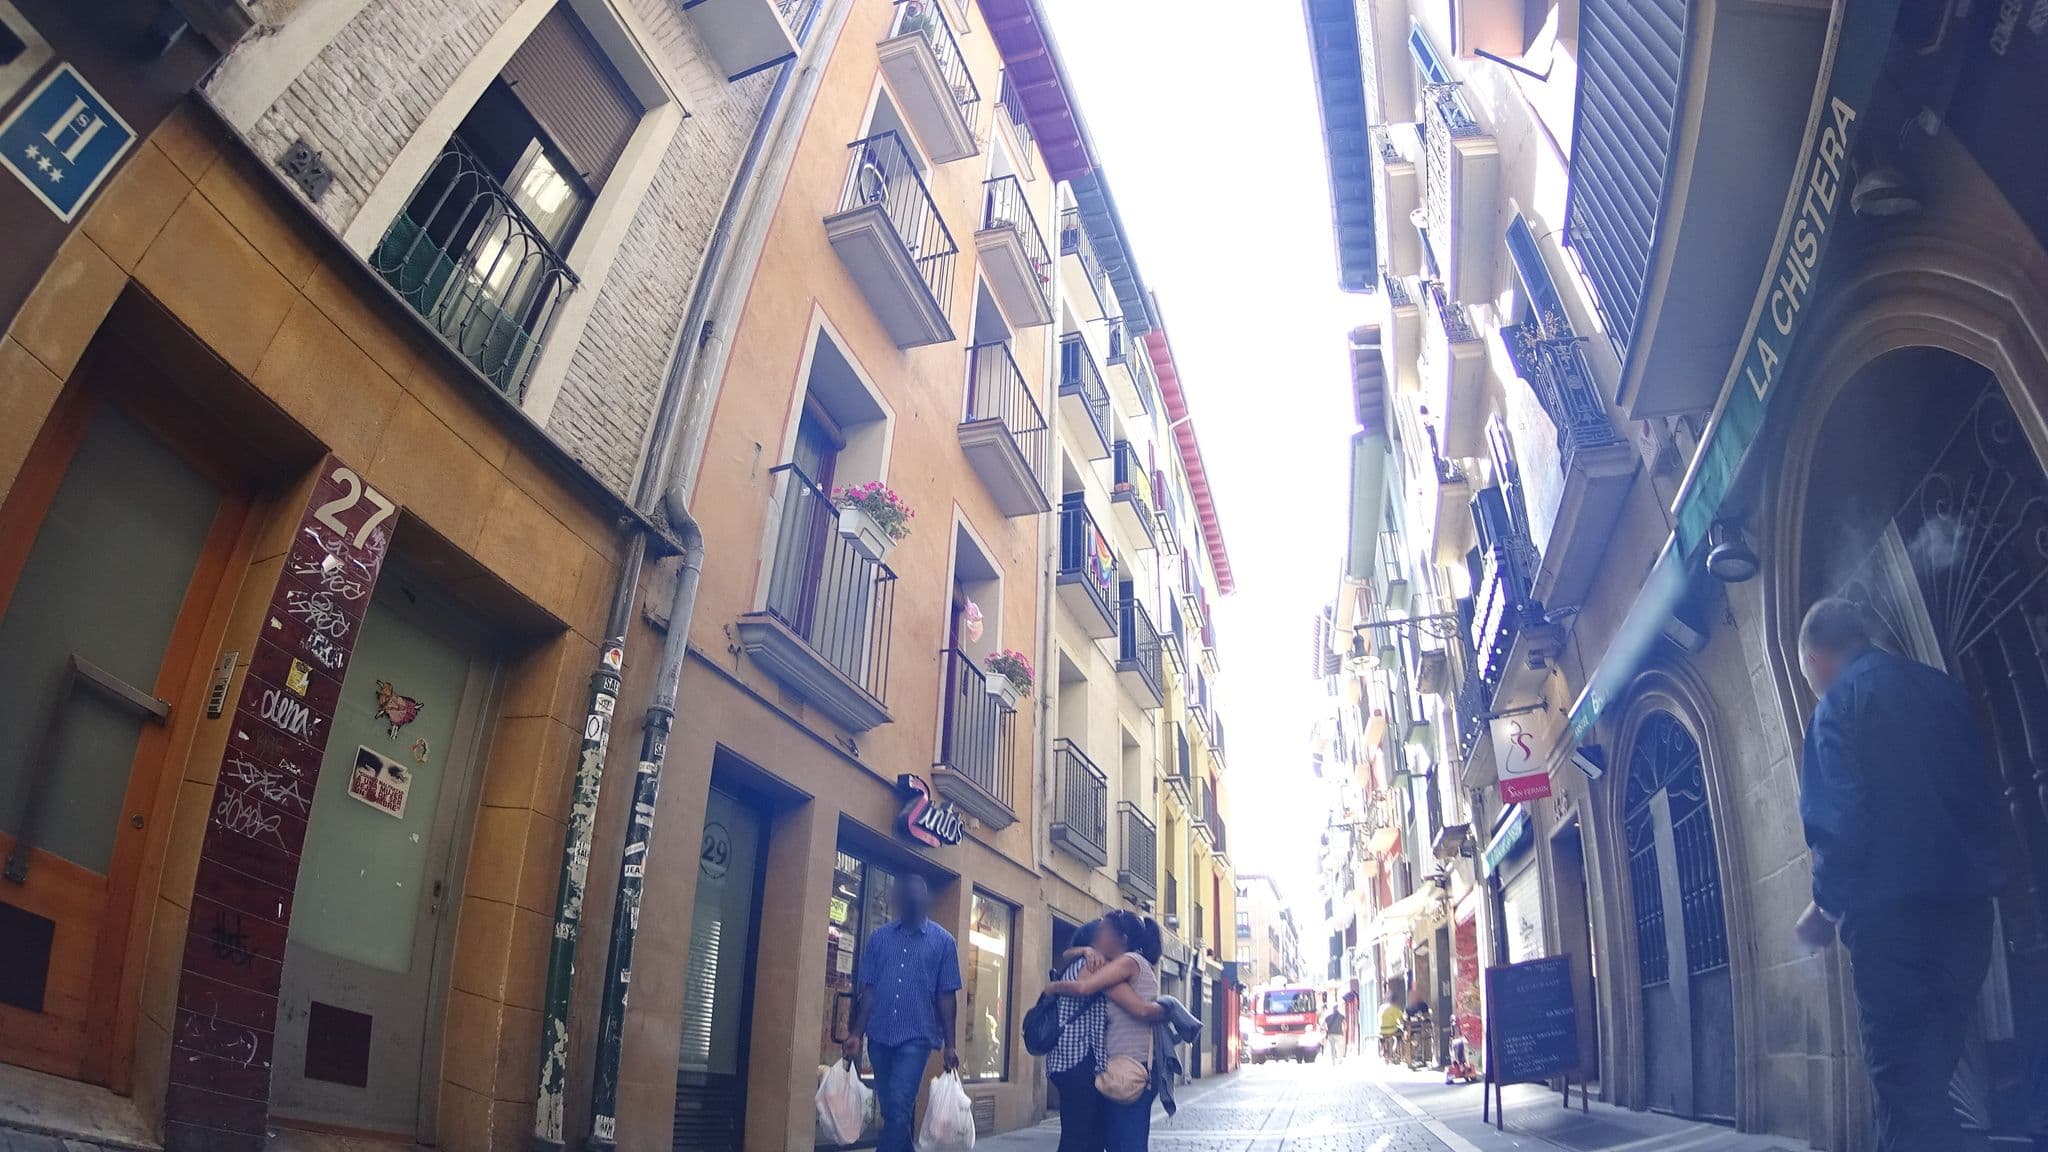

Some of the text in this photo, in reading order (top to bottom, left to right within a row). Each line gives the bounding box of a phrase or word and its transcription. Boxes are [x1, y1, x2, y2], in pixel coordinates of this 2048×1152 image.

[1746, 96, 1857, 402] LA CHISTERA
[313, 467, 396, 551] 27
[702, 835, 728, 865] 29
